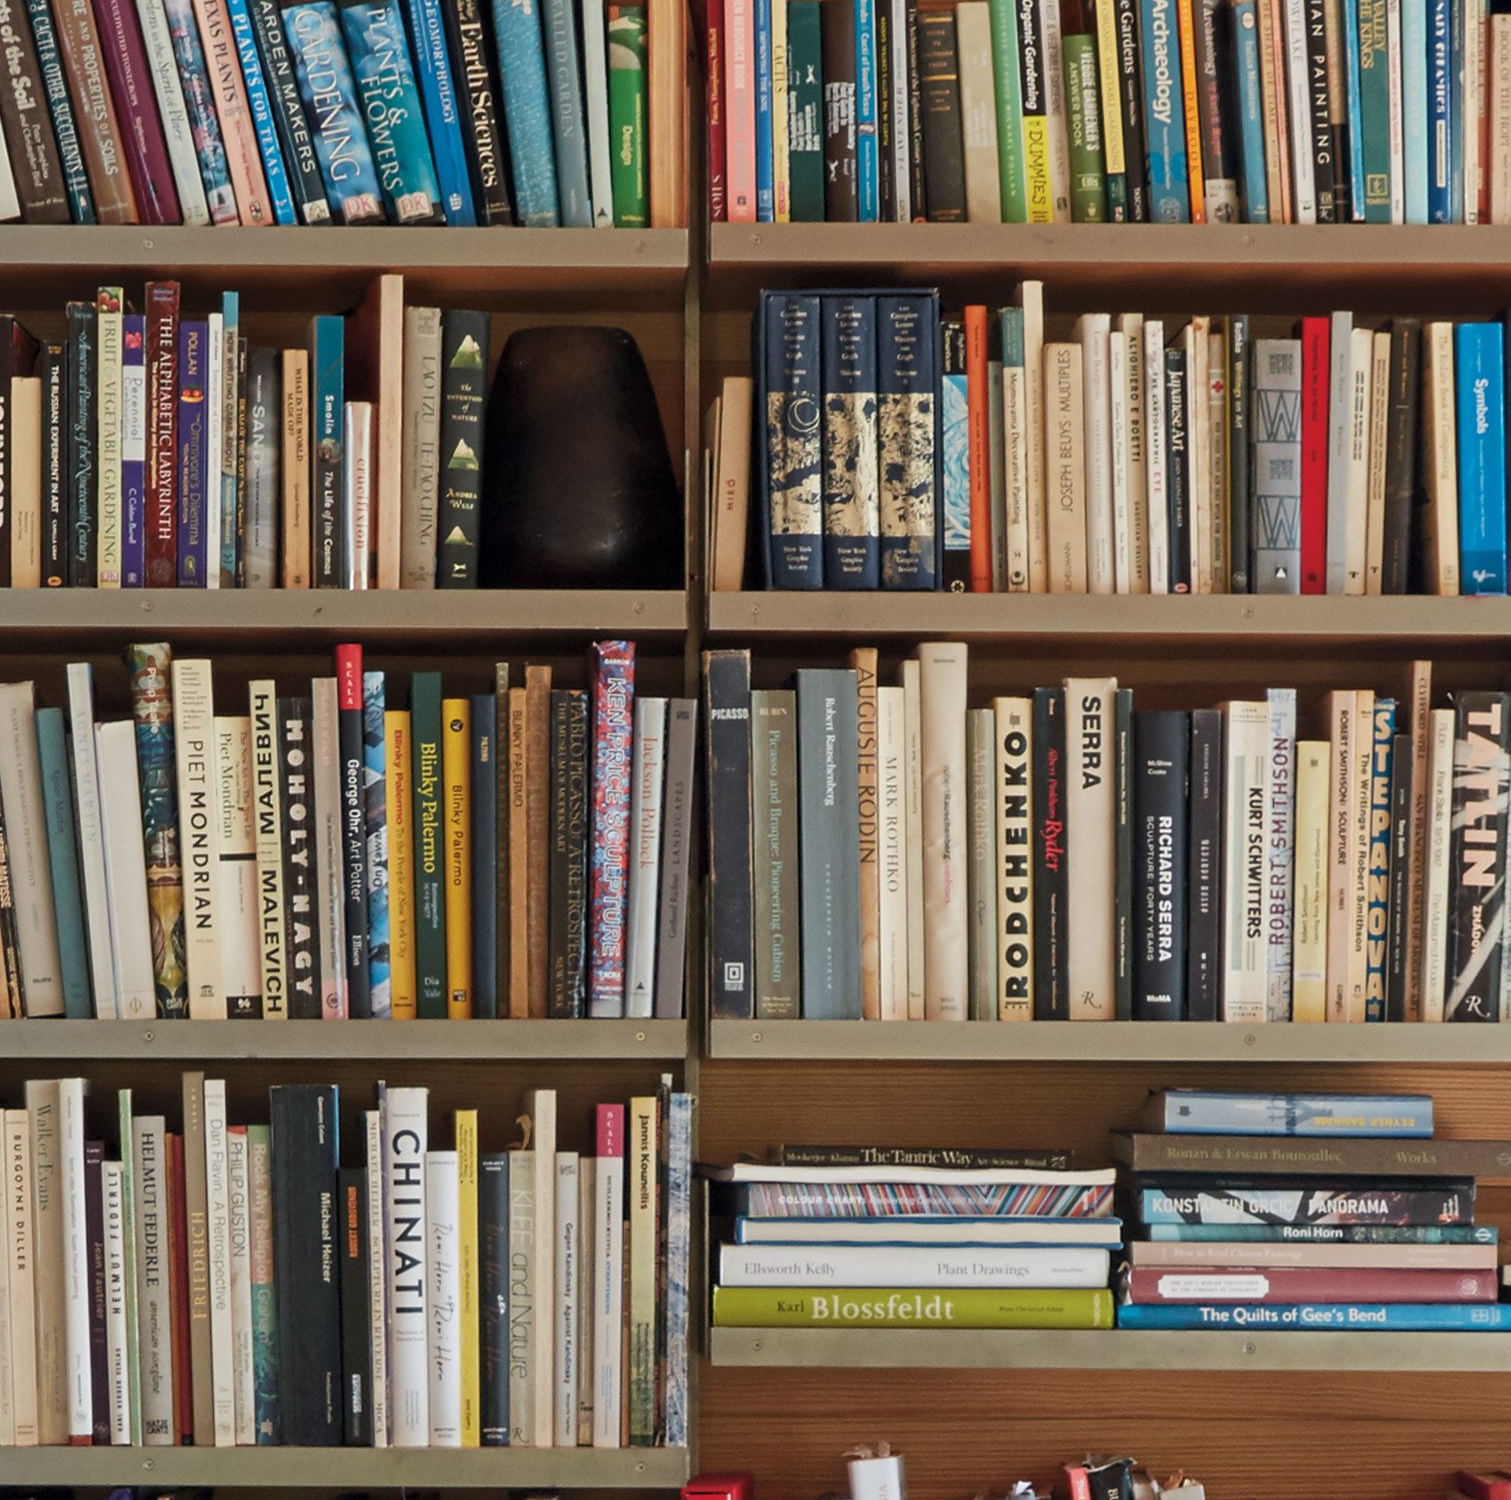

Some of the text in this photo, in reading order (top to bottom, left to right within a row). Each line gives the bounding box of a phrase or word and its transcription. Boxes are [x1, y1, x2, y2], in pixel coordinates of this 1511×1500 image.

[295, 8, 361, 182] GARDENING
[458, 22, 502, 188] Earth Sciences
[1023, 45, 1040, 109] Gardening
[1121, 11, 1136, 73] Gardens
[1313, 55, 1330, 165] PAINTING
[279, 83, 315, 173] MAKERS
[1029, 130, 1046, 204] DUMMIES
[158, 316, 173, 539] THE ALPHABETIC LABYRINTH
[1475, 378, 1489, 434] Symbols
[419, 742, 440, 873] Blinky Palermo
[1083, 695, 1102, 789] SERRA
[1462, 703, 1501, 886] TATLIN
[188, 739, 213, 929] PIET MONDRIAN
[286, 719, 312, 995] MOHOLY-NAGY
[1006, 731, 1029, 999] RODCHENKO
[1043, 819, 1064, 871] Ryder
[1157, 815, 1172, 961] RICHARD SERRA
[1247, 787, 1264, 938] KURT SCHWITTERS
[262, 868, 282, 1013] MALEVICH
[142, 1132, 159, 1286] HELMUT FEDERLE
[392, 1129, 424, 1315] CHINATI
[777, 1296, 953, 1319] Karl Blossfeldt
[1200, 1308, 1386, 1325] The Quilts of Gee's Bend
